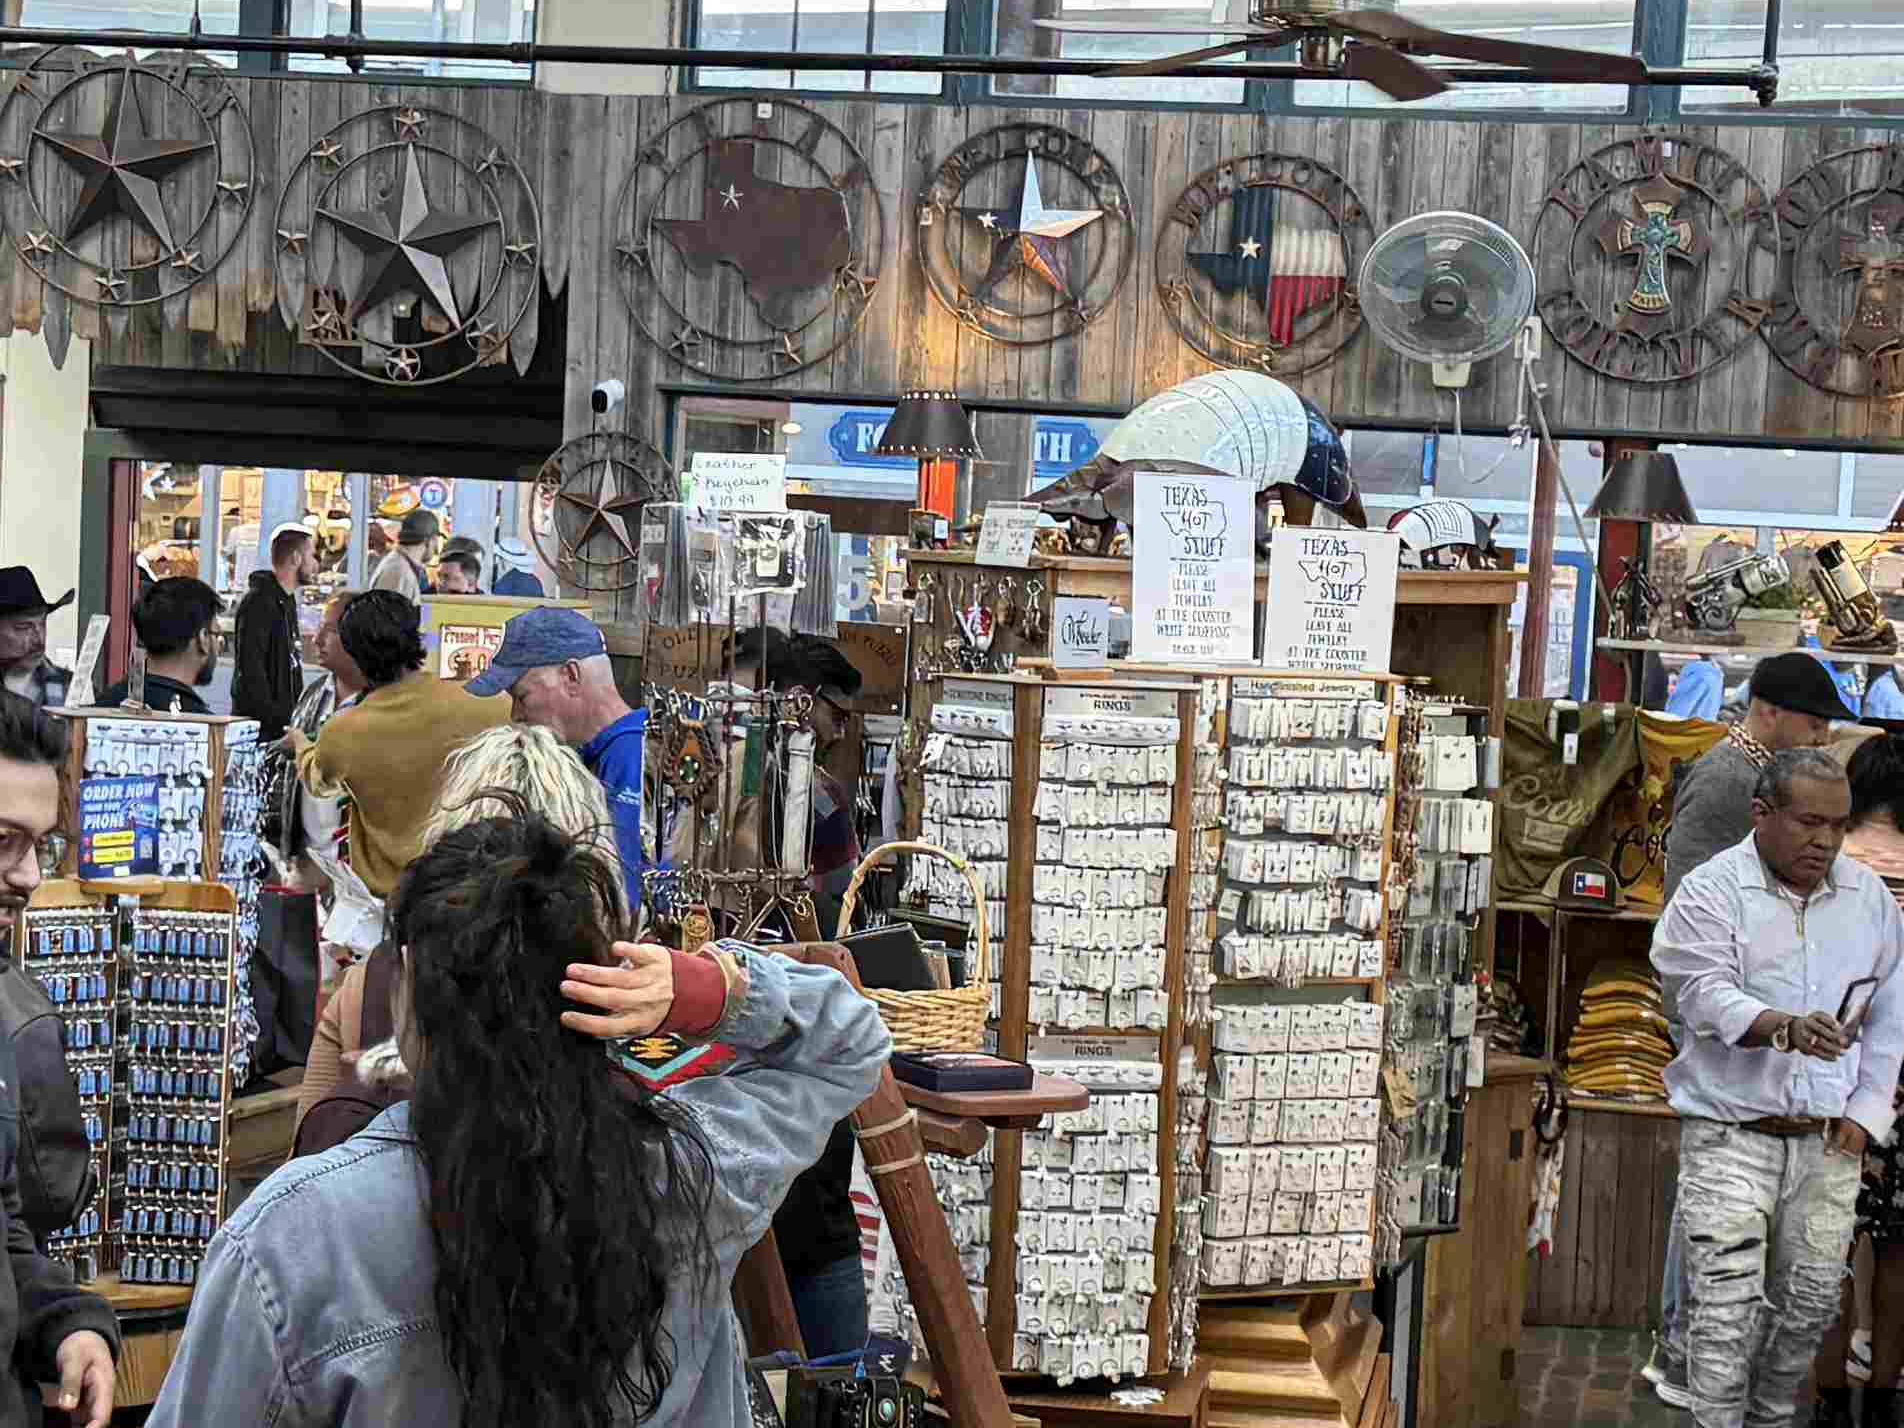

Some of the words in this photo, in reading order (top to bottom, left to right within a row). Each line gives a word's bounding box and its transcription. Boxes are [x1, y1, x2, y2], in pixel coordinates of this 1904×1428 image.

[1162, 484, 1209, 508] TEXAS
[1181, 510, 1211, 531] HOT
[1183, 536, 1226, 557] STUFF
[1301, 536, 1348, 557] TEXAS
[1177, 563, 1209, 576] PLEASE
[1319, 562, 1352, 576] HOT
[1172, 578, 1198, 592] LEAVE
[1201, 578, 1216, 592] ALL
[1319, 581, 1367, 602] STUFF
[1174, 593, 1214, 607] JEWELRY
[1155, 609, 1169, 622] AT
[1171, 610, 1189, 622] THE
[1192, 610, 1231, 623] COUNTER
[1312, 606, 1345, 620] PLEASE
[1305, 620, 1332, 633] LEAVE
[1336, 621, 1352, 633] ALL
[1307, 634, 1348, 647] JEWELRY
[1094, 699, 1132, 712] RINGS
[83, 785, 124, 801] ORDER
[125, 782, 156, 798] NOW
[84, 812, 125, 829] PHONE
[1073, 1044, 1115, 1058] RINGS
